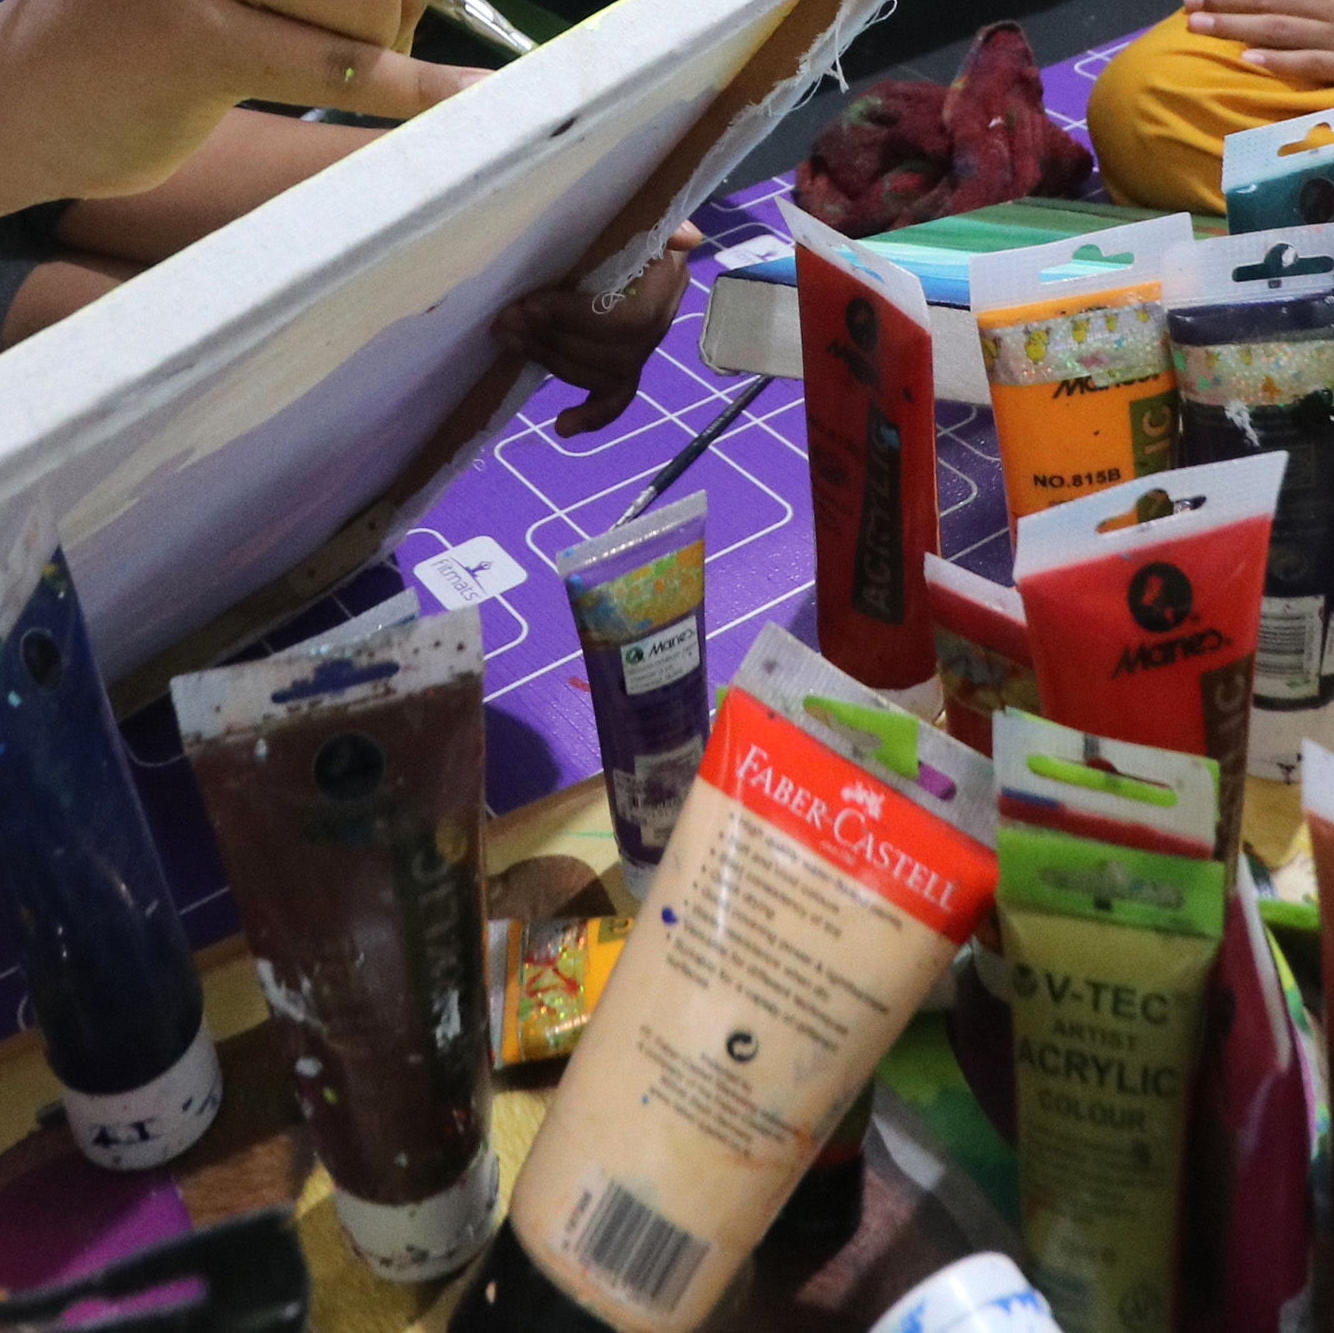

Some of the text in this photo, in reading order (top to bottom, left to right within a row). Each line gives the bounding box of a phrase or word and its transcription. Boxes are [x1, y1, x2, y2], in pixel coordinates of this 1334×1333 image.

[1033, 468, 1121, 489] NO.815B
[1045, 972, 1169, 1025] V-TEC
[1019, 1037, 1178, 1099] ACRYLIC
